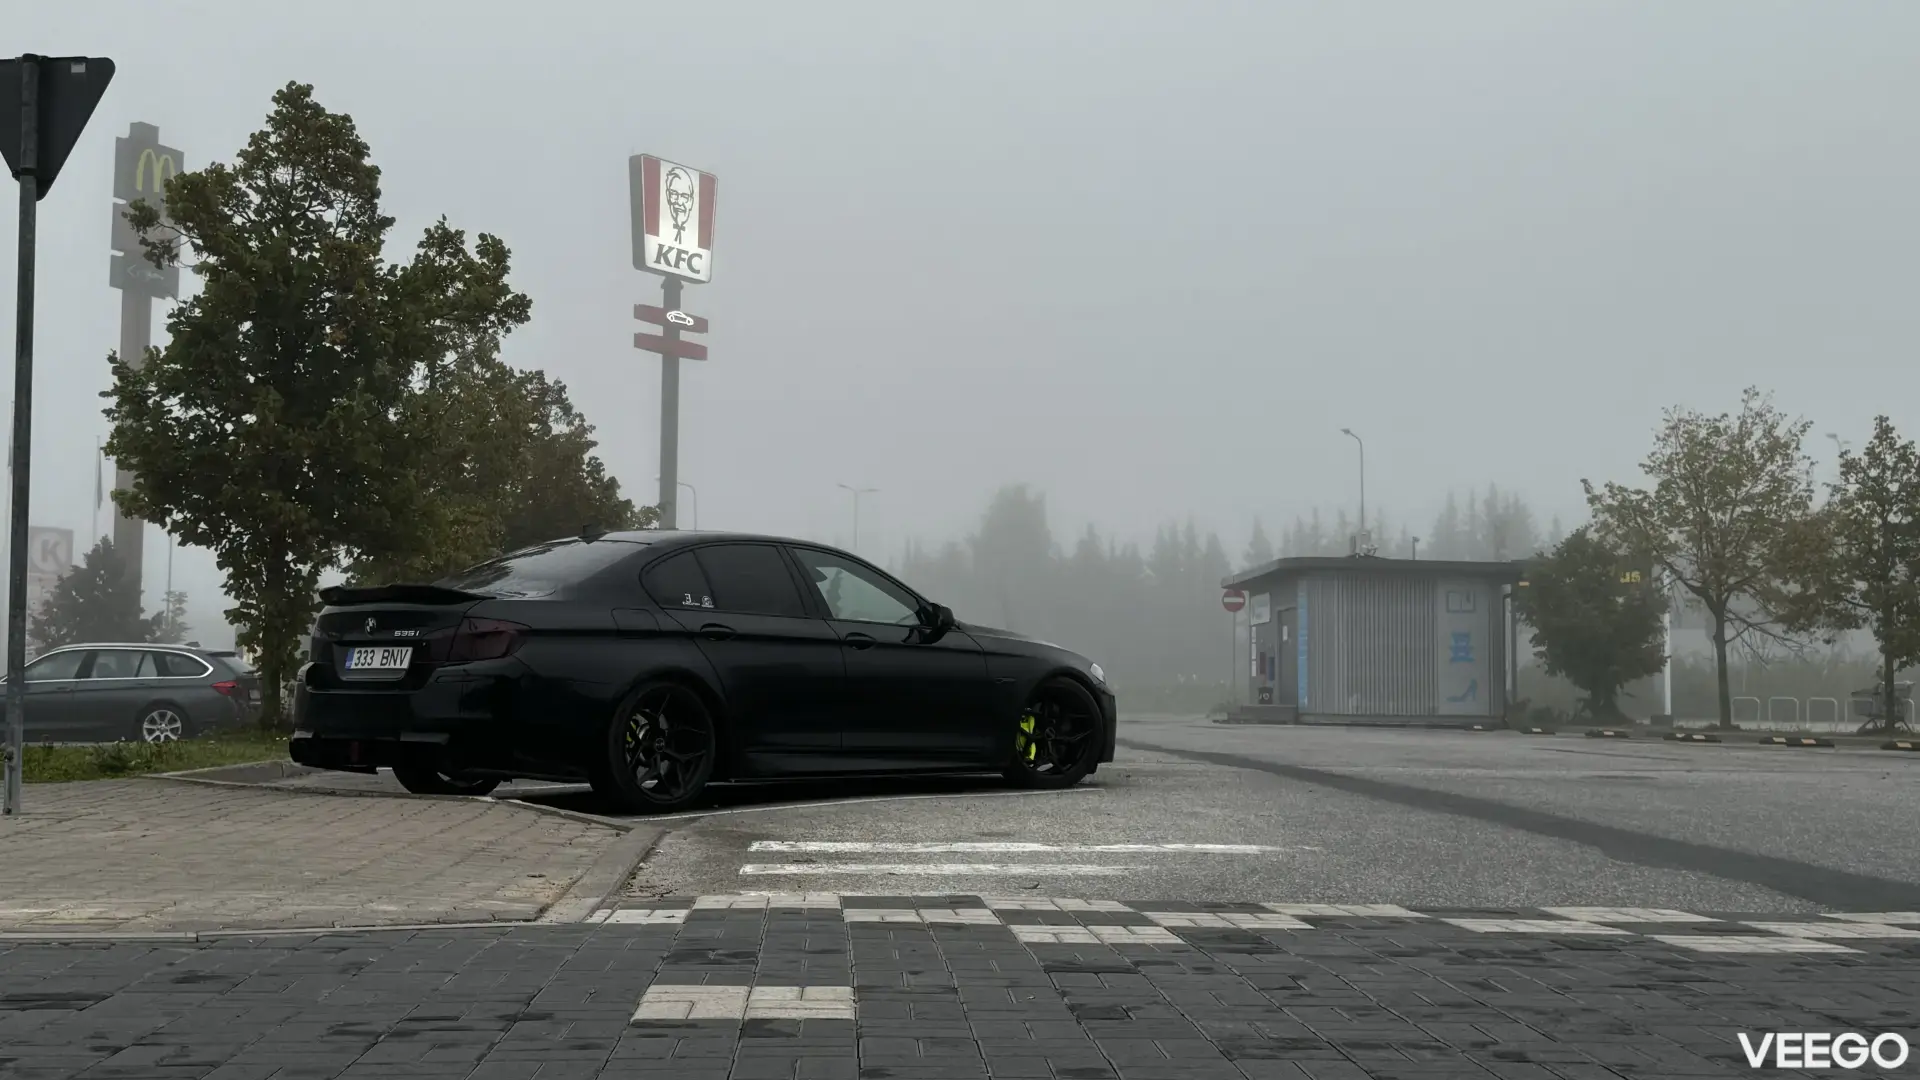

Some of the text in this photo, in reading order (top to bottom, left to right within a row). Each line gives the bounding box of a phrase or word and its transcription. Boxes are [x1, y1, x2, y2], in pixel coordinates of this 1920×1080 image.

[654, 244, 702, 275] KFC
[41, 539, 62, 566] K
[354, 648, 411, 667] 333 BNV
